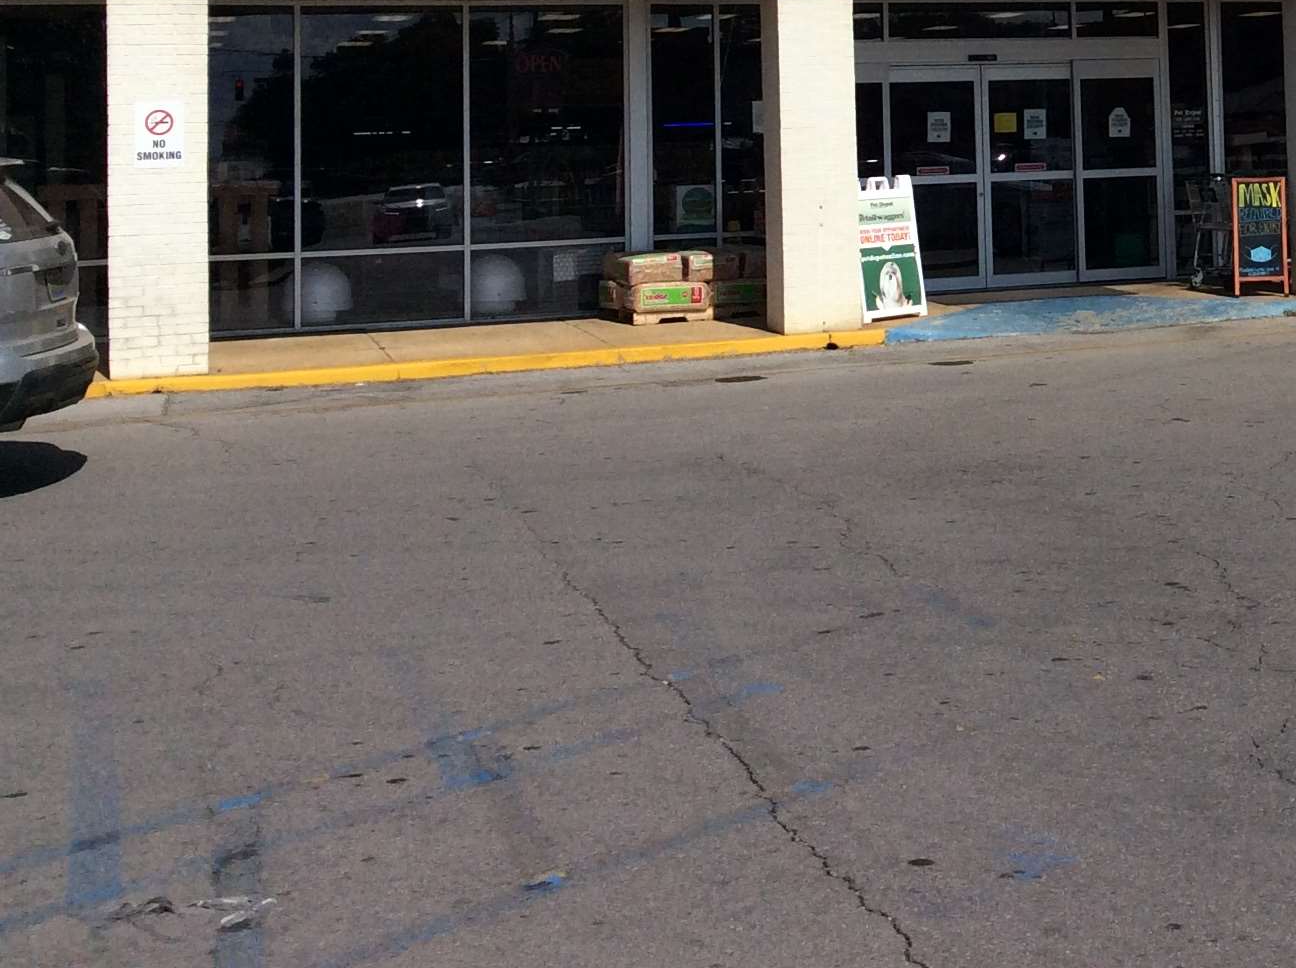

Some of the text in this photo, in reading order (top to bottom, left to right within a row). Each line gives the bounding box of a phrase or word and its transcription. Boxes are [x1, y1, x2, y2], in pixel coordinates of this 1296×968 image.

[152, 138, 166, 149] NO
[136, 150, 182, 161] SMOKING
[1238, 181, 1282, 208] MASK
